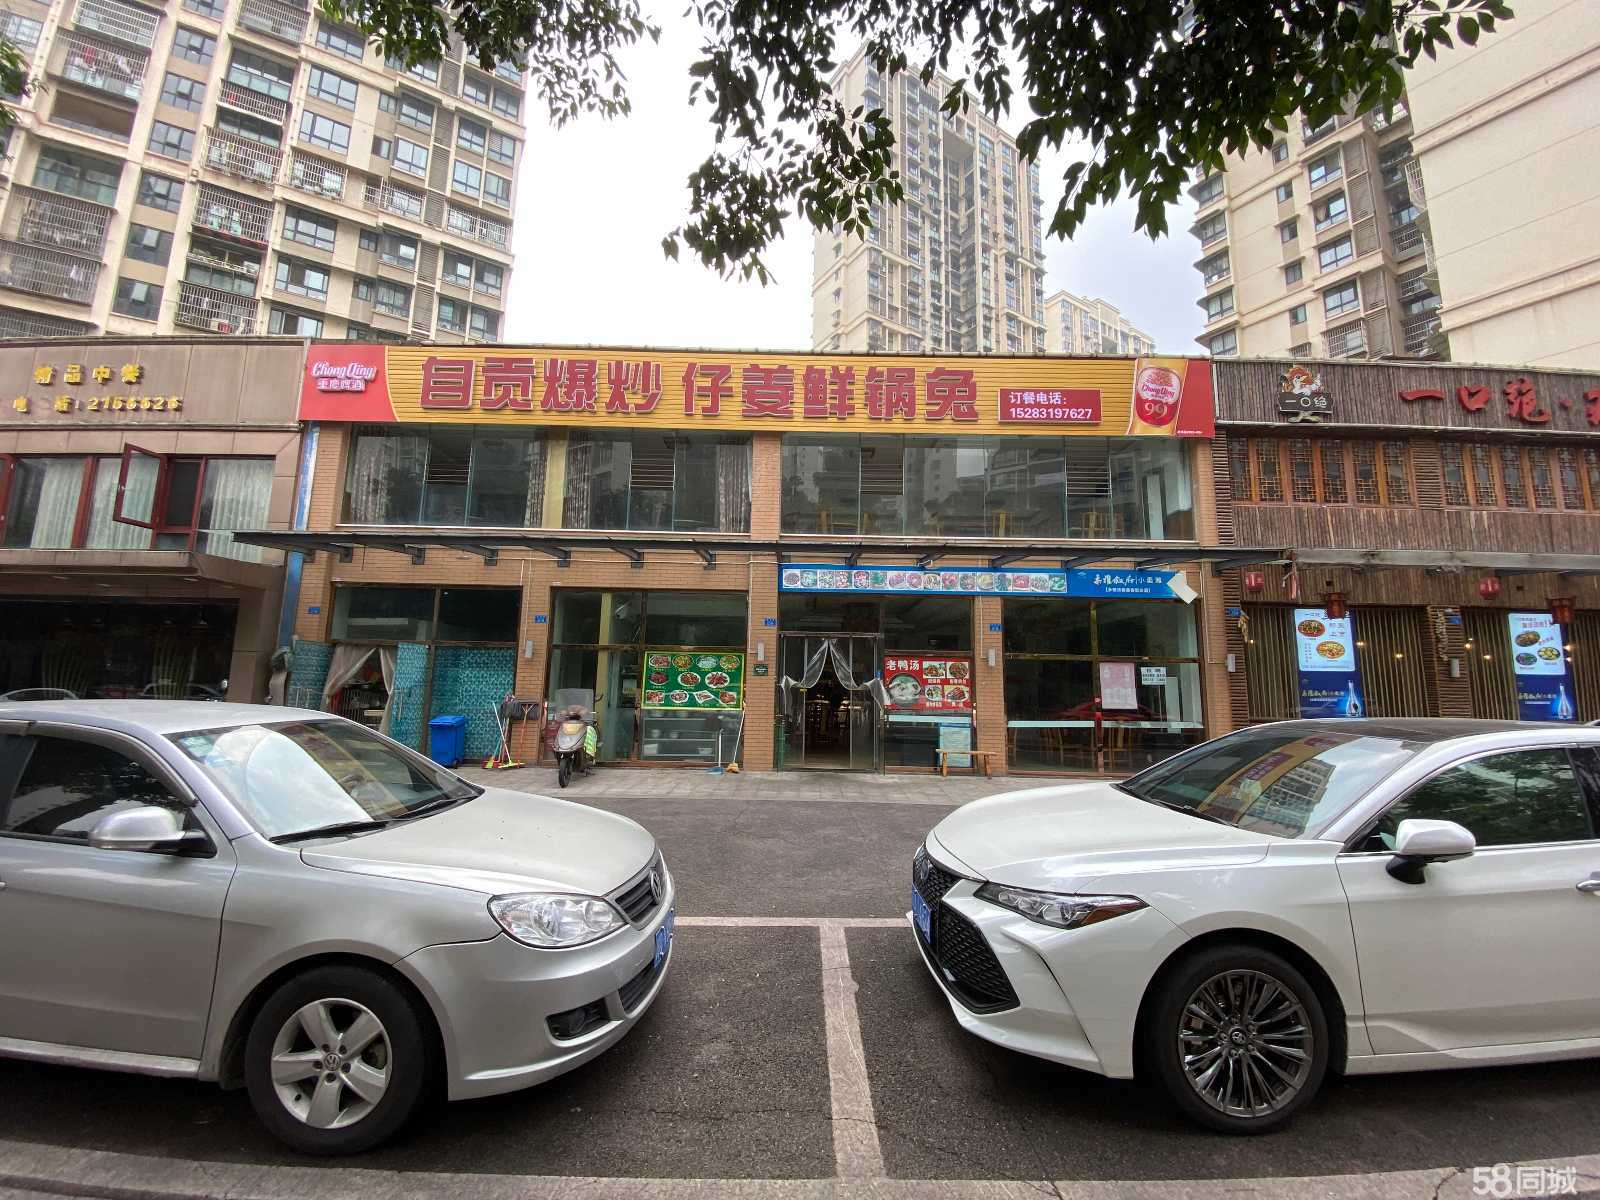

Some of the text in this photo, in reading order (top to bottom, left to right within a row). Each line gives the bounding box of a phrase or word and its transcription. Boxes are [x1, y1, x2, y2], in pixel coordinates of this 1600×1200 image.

[420, 355, 979, 421] 自贡爆炒仔姜鲜锅兔
[1009, 407, 1093, 419] 15283197627
[886, 659, 920, 671] 老鸭汤
